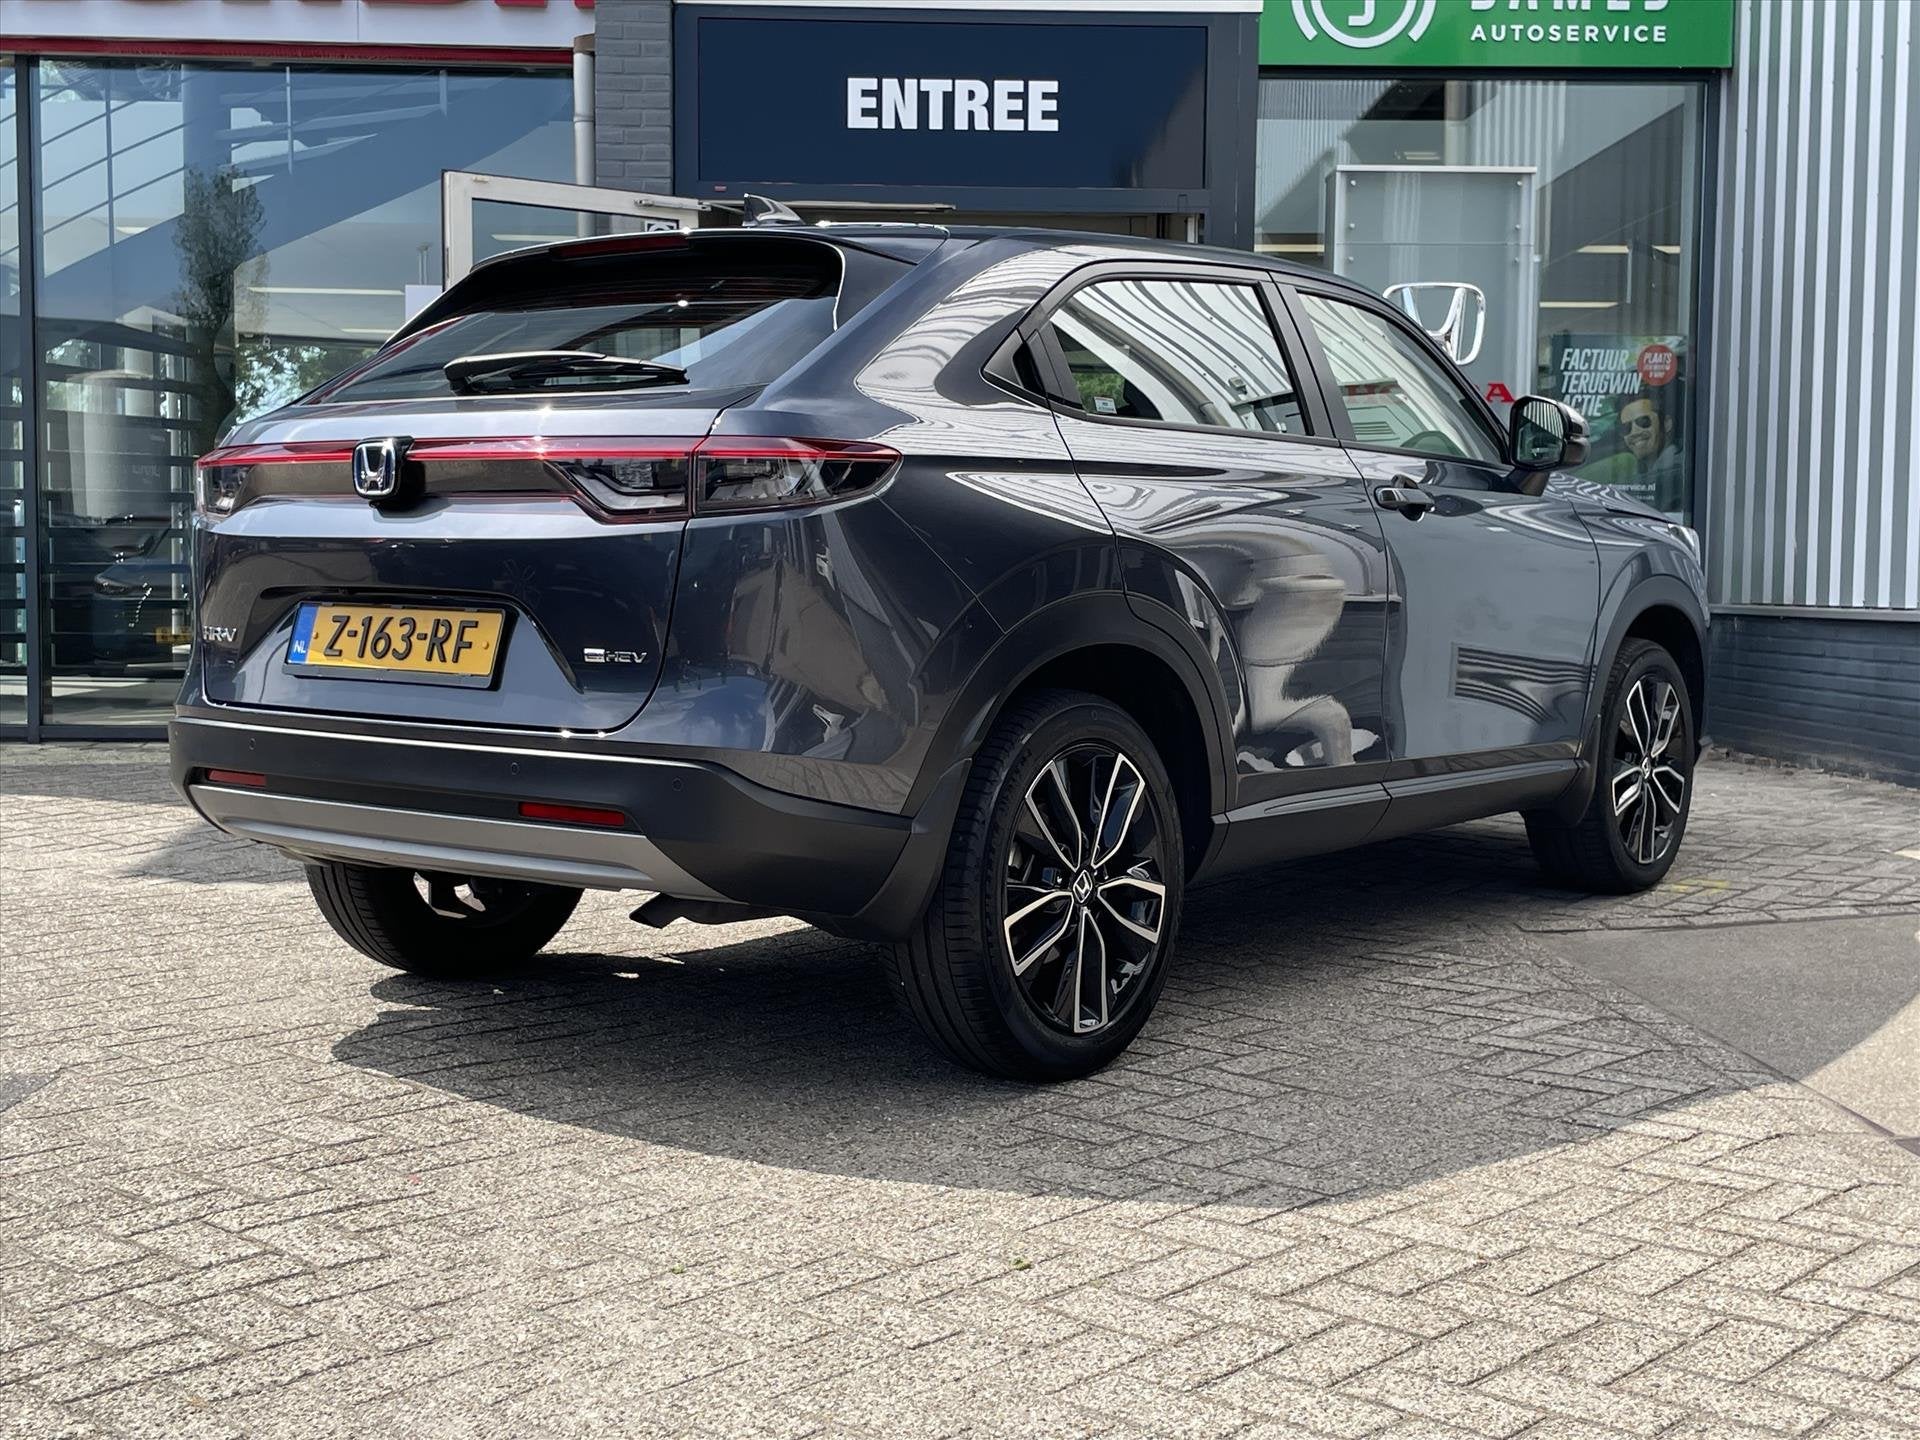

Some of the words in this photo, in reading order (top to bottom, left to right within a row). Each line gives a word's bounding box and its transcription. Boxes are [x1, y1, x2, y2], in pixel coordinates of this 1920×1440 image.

[1471, 24, 1667, 42] AUTOSERVICE
[847, 77, 1059, 131] ENTREE
[1560, 348, 1629, 371] FACTUUR
[1561, 371, 1643, 394] TERUGWIN
[203, 625, 237, 643] HR-V
[323, 614, 479, 664] Z-163-RF
[293, 640, 307, 654] NL
